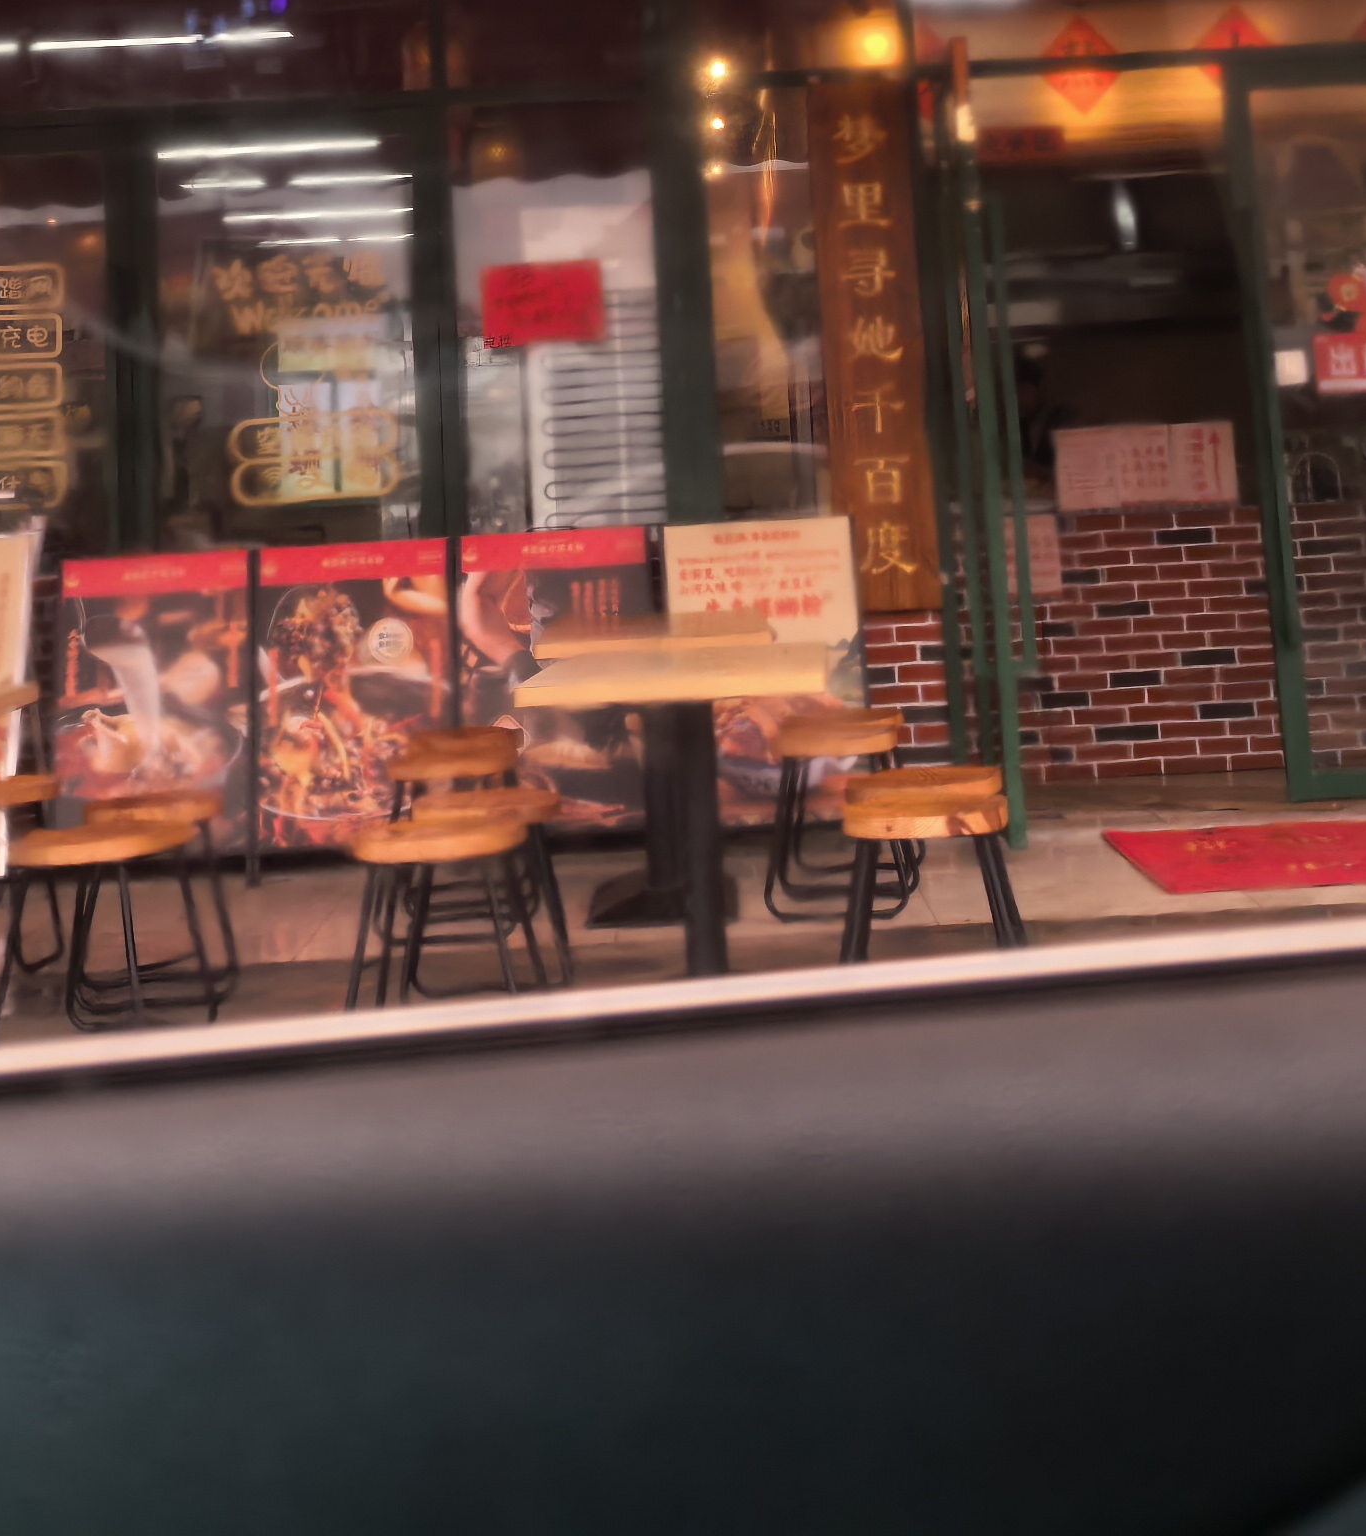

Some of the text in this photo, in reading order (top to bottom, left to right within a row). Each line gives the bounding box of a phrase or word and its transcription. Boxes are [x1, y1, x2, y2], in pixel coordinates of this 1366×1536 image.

[834, 113, 919, 576] 梦里寻她千百度
